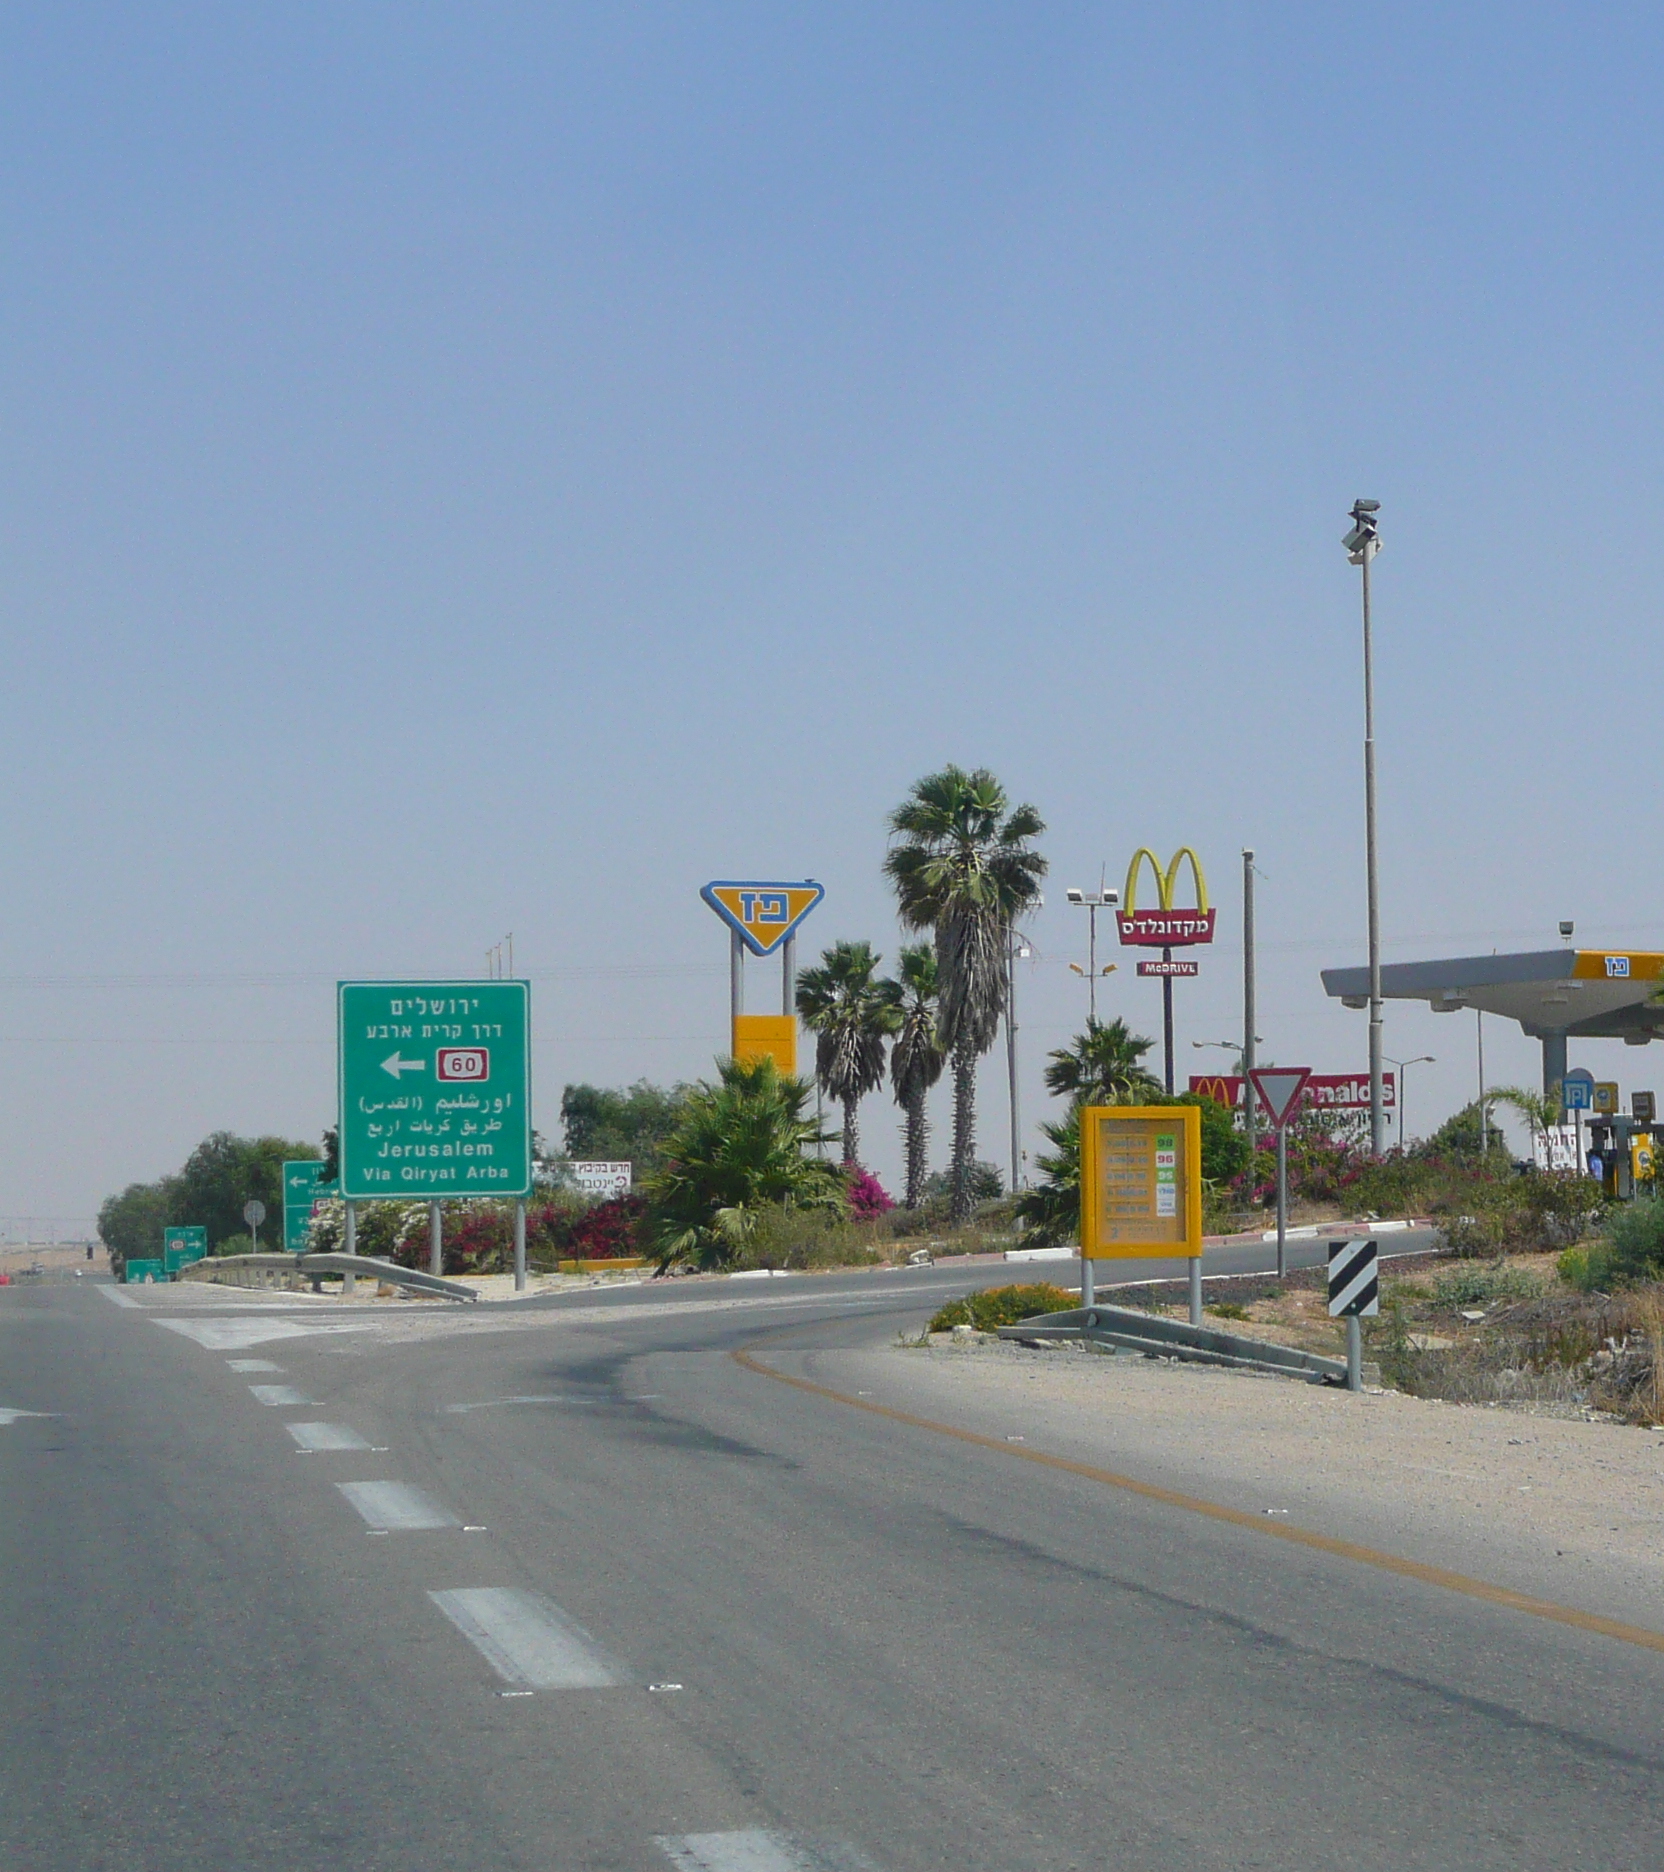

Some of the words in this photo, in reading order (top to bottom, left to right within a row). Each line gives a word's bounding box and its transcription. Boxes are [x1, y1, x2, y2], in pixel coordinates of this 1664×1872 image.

[739, 891, 789, 924] פז
[1145, 963, 1195, 973] McDRIVE
[1605, 956, 1629, 977] פז
[391, 997, 479, 1016] ירושלים
[367, 1024, 412, 1039] ארבע
[422, 1024, 462, 1039] קרית
[472, 1024, 502, 1039] דרך
[452, 1057, 476, 1072] 60
[436, 1093, 512, 1115] اورشليم
[410, 1118, 450, 1136] كريات
[460, 1118, 502, 1136] طريق
[378, 1141, 494, 1157] Jerusalem
[1158, 1155, 1173, 1163] 96
[363, 1168, 391, 1180] Via
[401, 1166, 456, 1182] Qiryat
[466, 1166, 509, 1179] Arba
